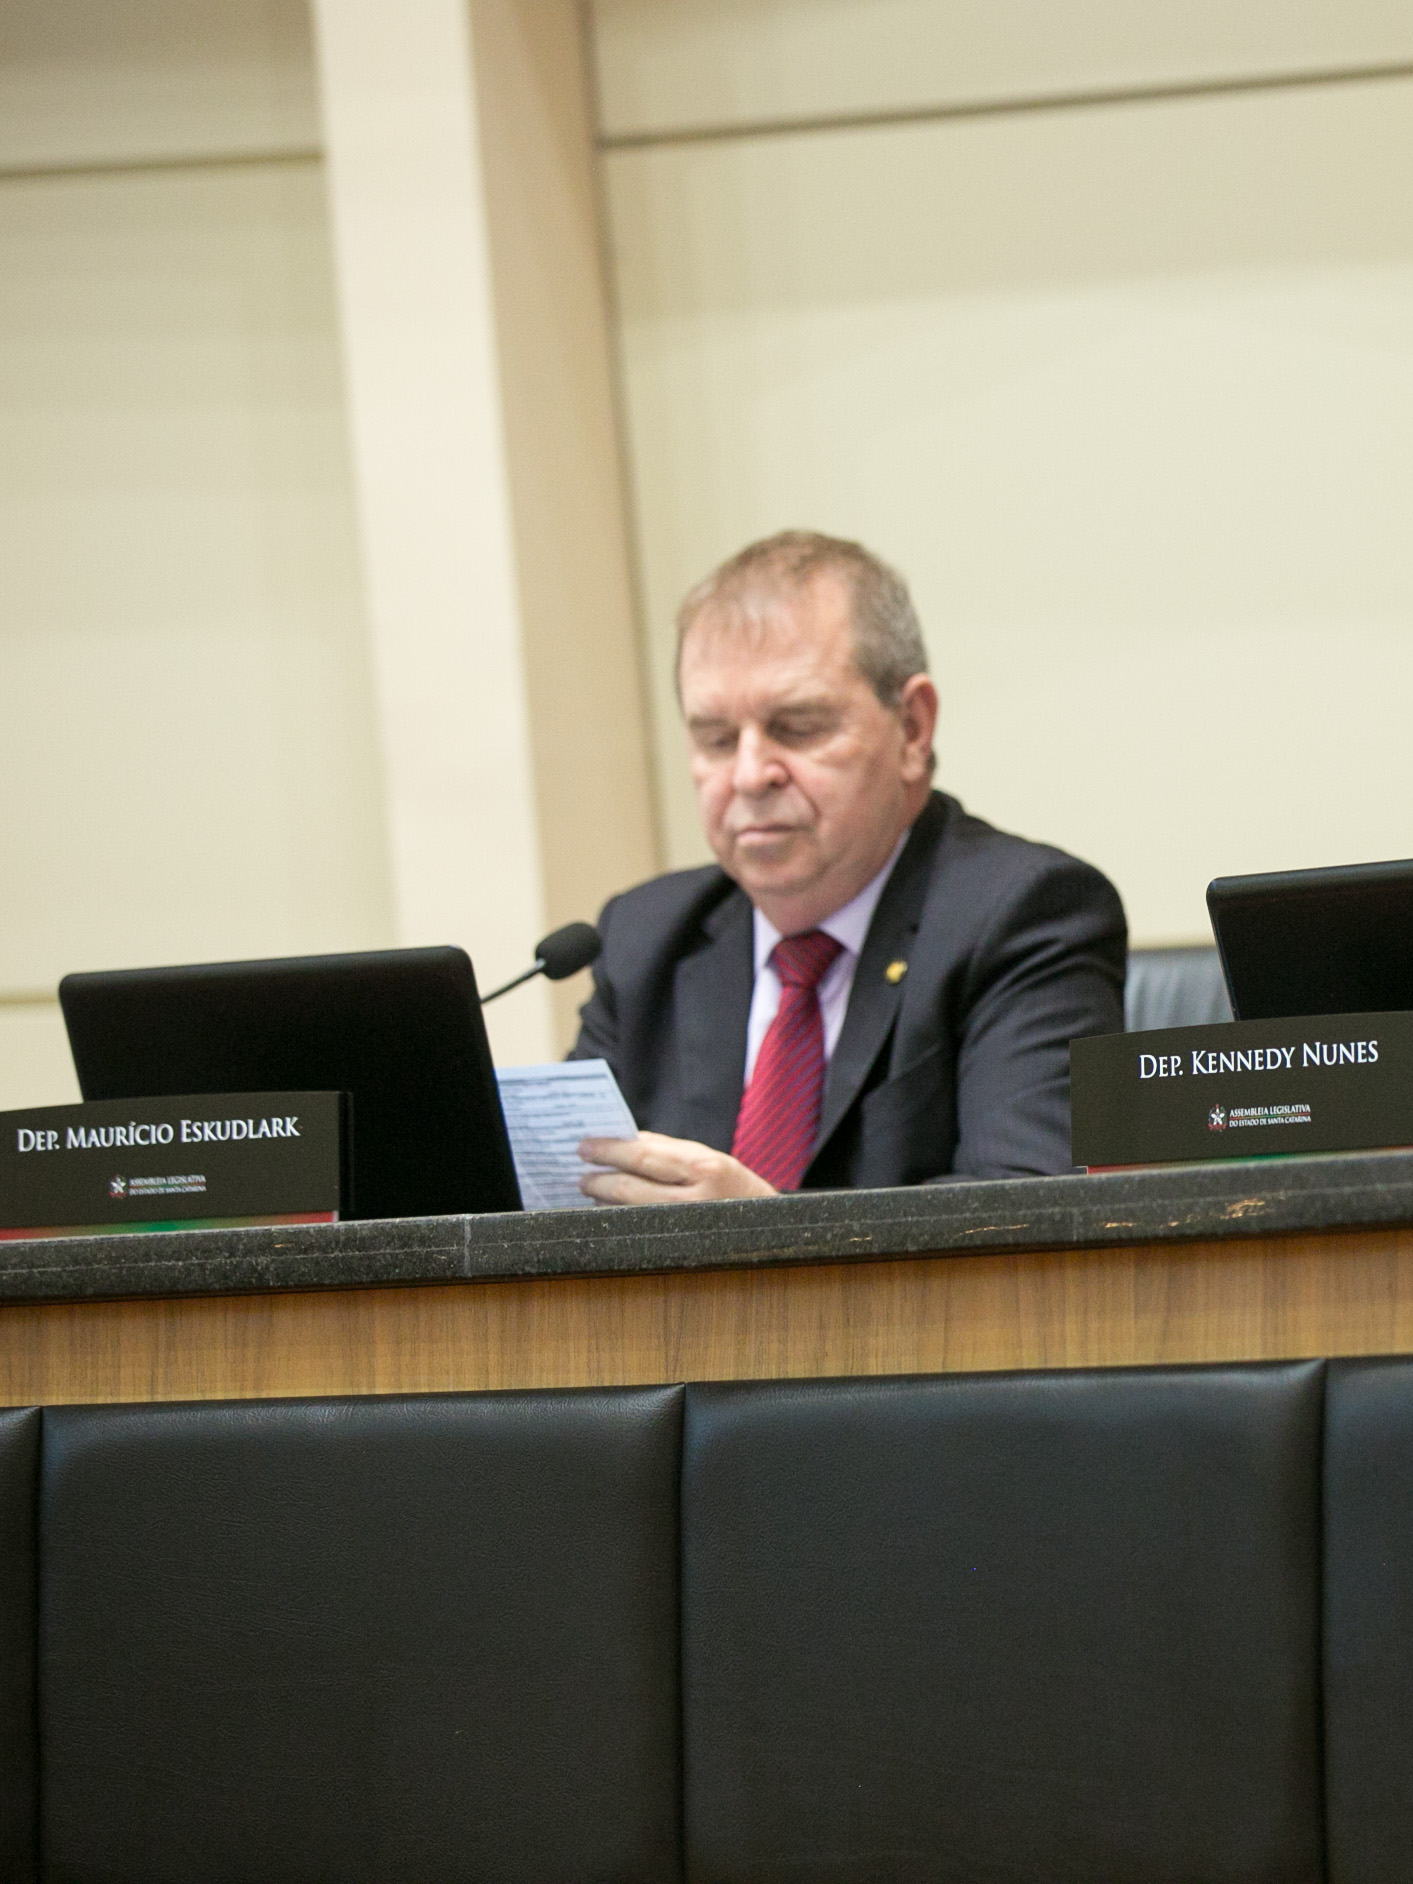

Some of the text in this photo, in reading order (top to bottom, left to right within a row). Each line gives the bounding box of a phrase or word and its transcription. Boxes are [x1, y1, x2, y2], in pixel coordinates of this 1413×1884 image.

[1138, 1040, 1379, 1080] DEP. KENNEDY NUNES
[1229, 1104, 1311, 1117] ASSEMBLEIA LEGISLATIVA
[1268, 1117, 1284, 1125] SANTA
[1285, 1115, 1311, 1123] CATARINA
[16, 1117, 301, 1153] DEP. MAURÍCIO ESKUDLARK
